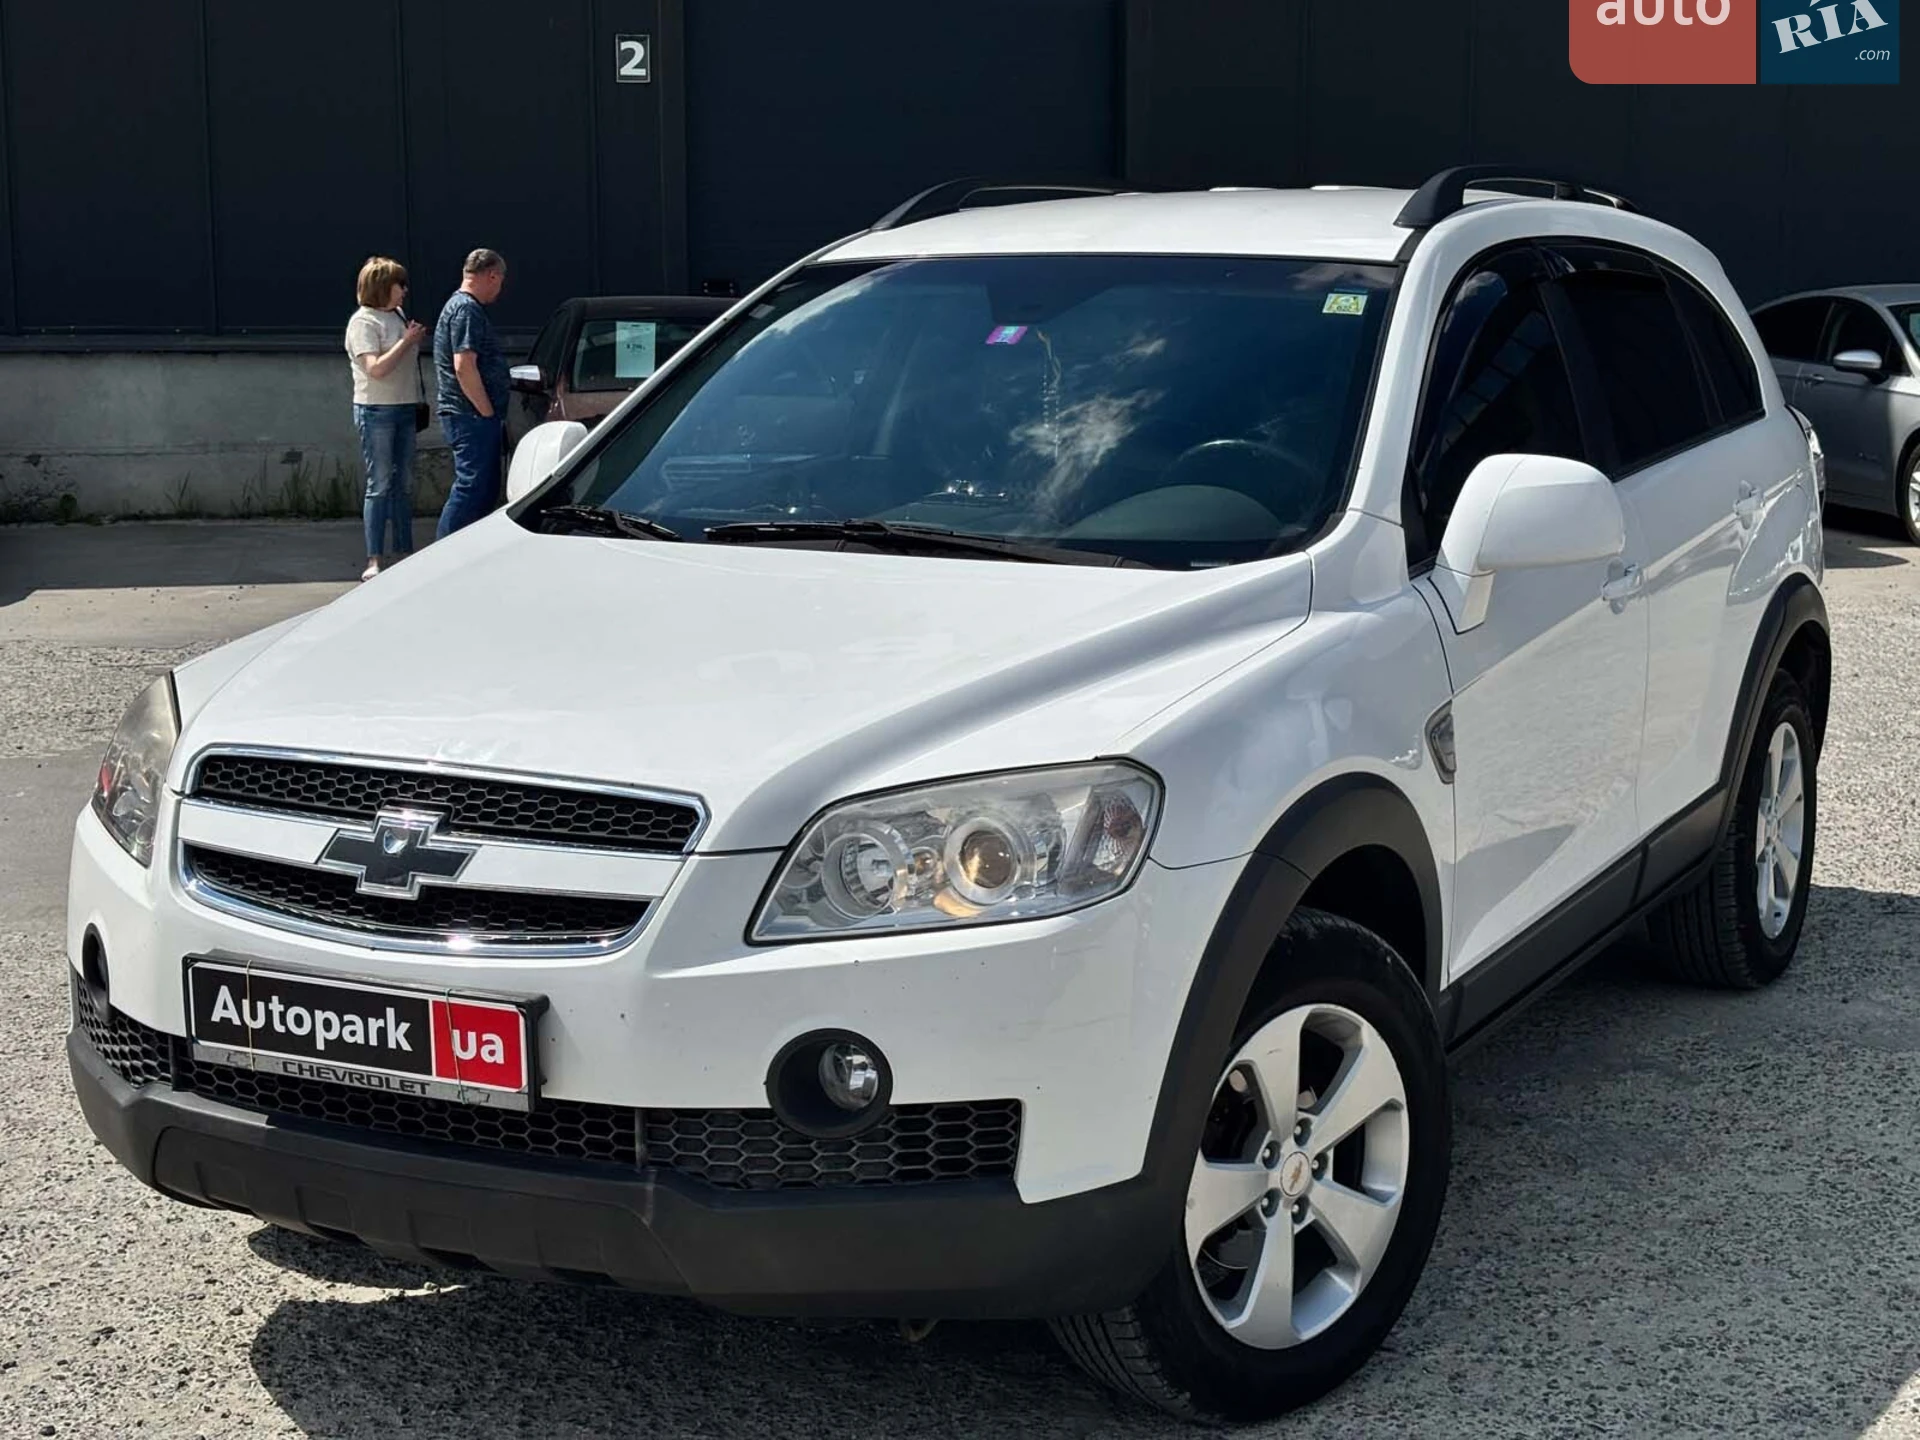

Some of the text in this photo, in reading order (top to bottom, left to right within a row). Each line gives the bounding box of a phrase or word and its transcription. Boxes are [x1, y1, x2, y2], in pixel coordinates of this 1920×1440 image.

[620, 40, 646, 76] 2
[211, 985, 505, 1065] Autopark ua
[281, 1061, 431, 1096] CHEVROLET
